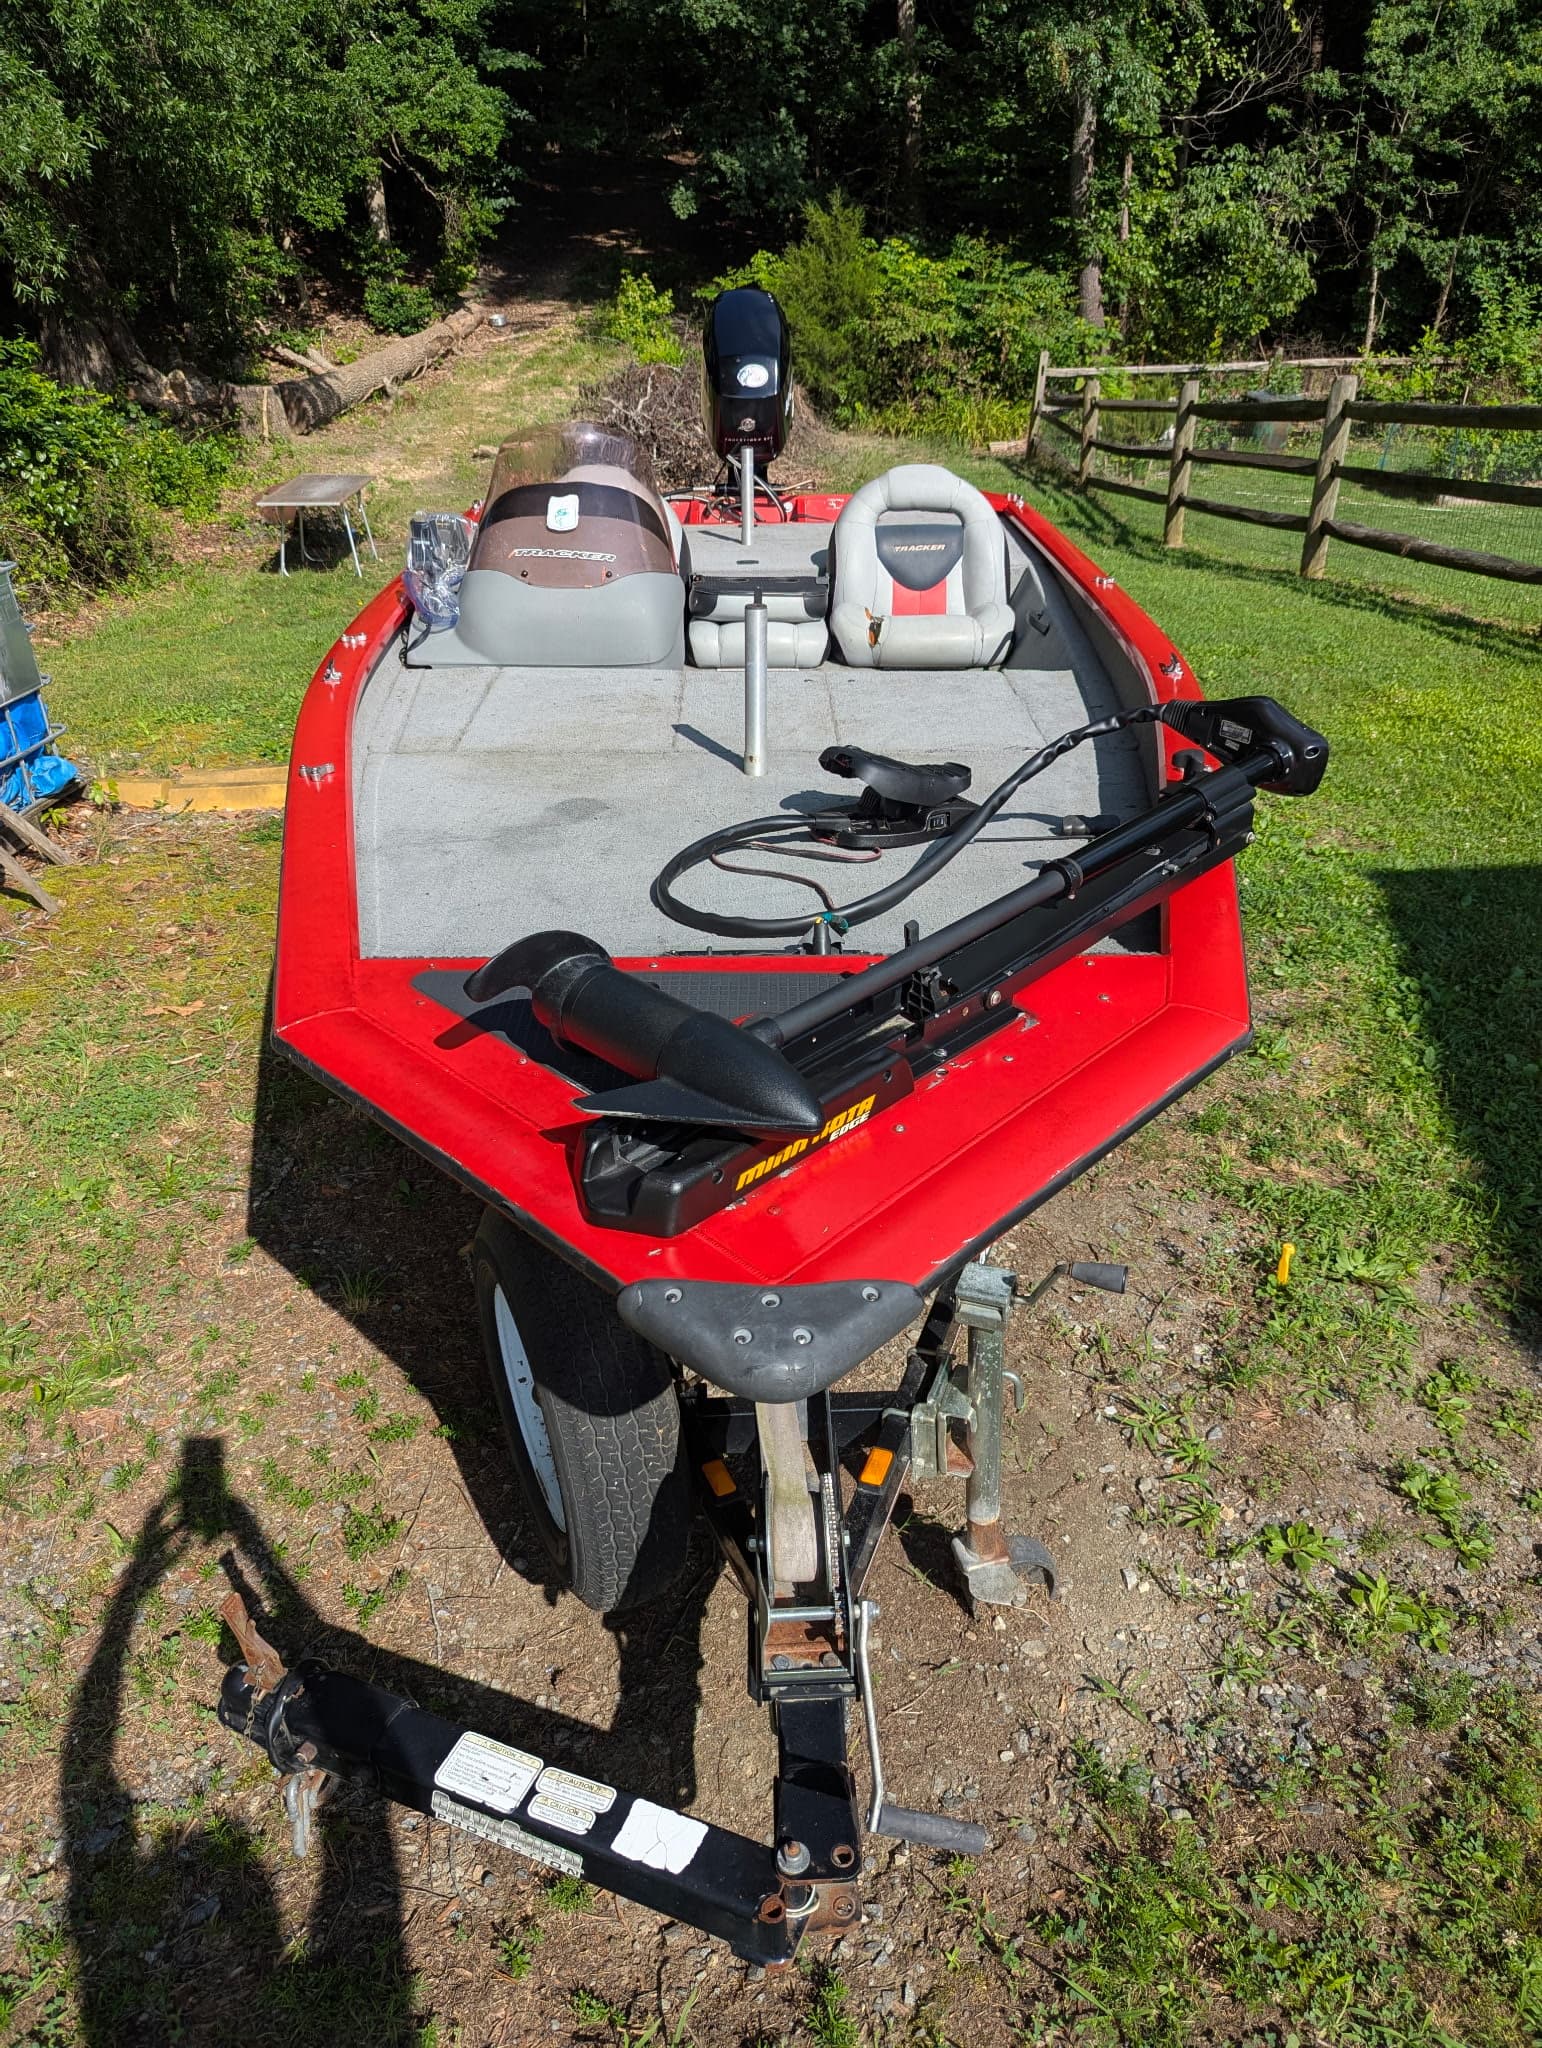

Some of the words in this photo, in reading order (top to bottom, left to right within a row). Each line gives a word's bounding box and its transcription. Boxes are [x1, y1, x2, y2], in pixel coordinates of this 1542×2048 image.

[510, 548, 617, 562] TRACKER
[894, 544, 946, 552] TRACKER
[829, 1110, 870, 1142] EDGE
[563, 1776, 595, 1791] CAUTION
[549, 1801, 579, 1816] CAUTION
